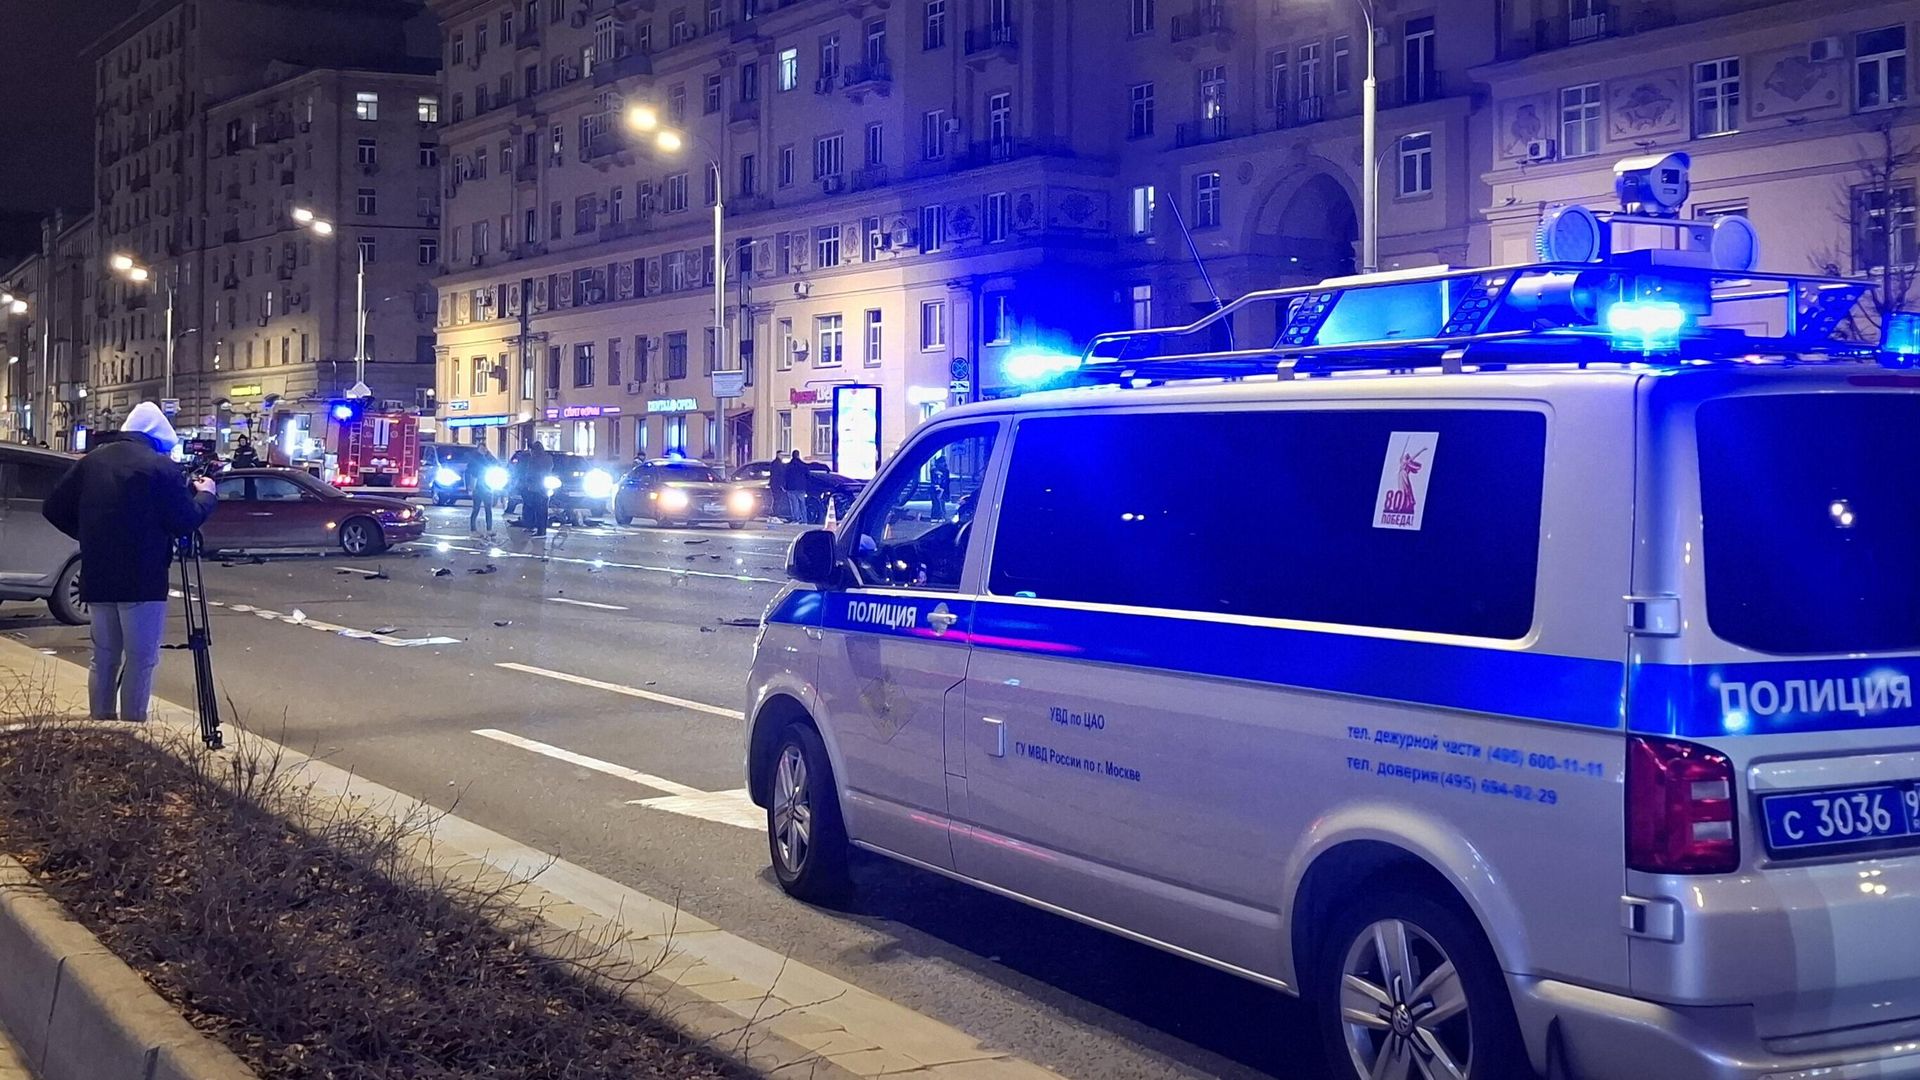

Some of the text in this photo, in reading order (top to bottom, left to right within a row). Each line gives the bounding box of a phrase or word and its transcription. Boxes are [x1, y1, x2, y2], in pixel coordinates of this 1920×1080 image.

[1384, 490, 1403, 511] 80
[1381, 514, 1414, 527] ПОБЕДА!
[847, 601, 917, 629] ПОЛИЦИЯ
[1720, 675, 1912, 719] ПОЛИЦИЯ
[1050, 707, 1105, 730] УВД по ЦАО
[1016, 742, 1140, 781] ГУ МВД России по г. Москве
[1347, 726, 1371, 741] тел.
[1374, 729, 1438, 751] дежурной
[1442, 741, 1480, 758] части
[1529, 753, 1603, 776] 600-11-11
[1347, 755, 1373, 771] тел.
[1812, 793, 1891, 837] 3036
[1905, 791, 1920, 817] 9
